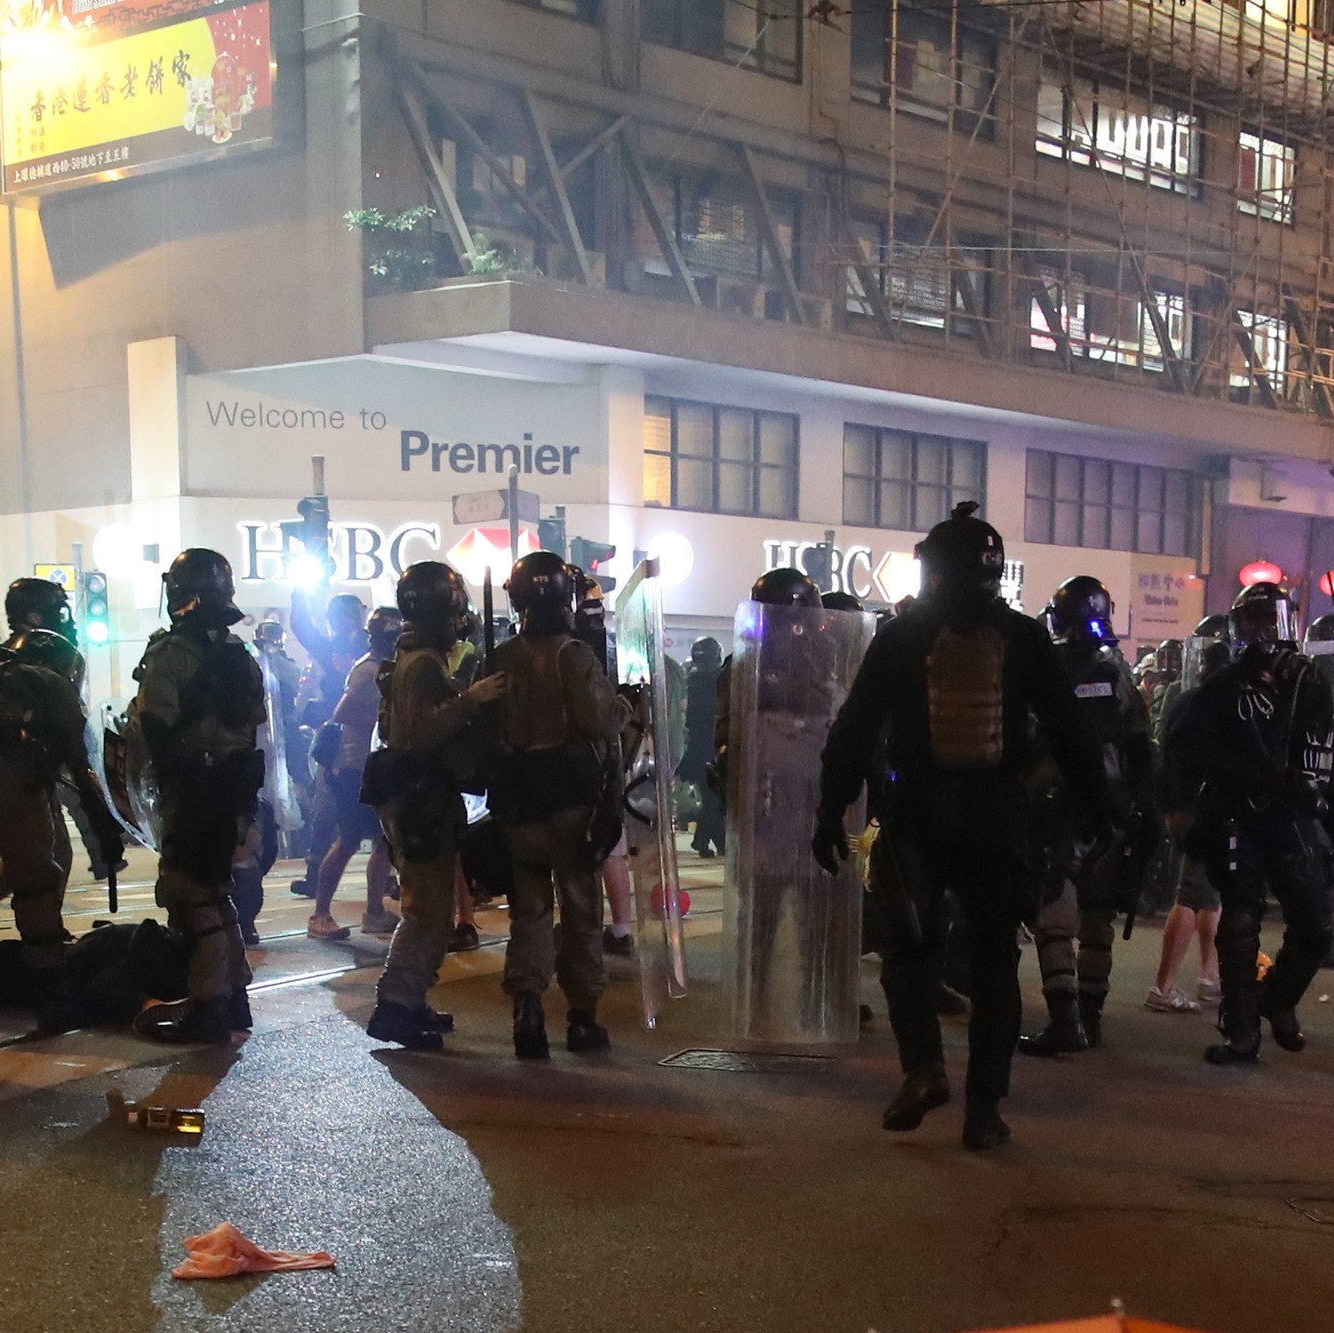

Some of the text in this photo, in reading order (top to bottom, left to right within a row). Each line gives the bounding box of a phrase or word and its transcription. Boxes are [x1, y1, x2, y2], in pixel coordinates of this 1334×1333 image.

[206, 401, 387, 430] Welcome to
[400, 430, 580, 475] Premier
